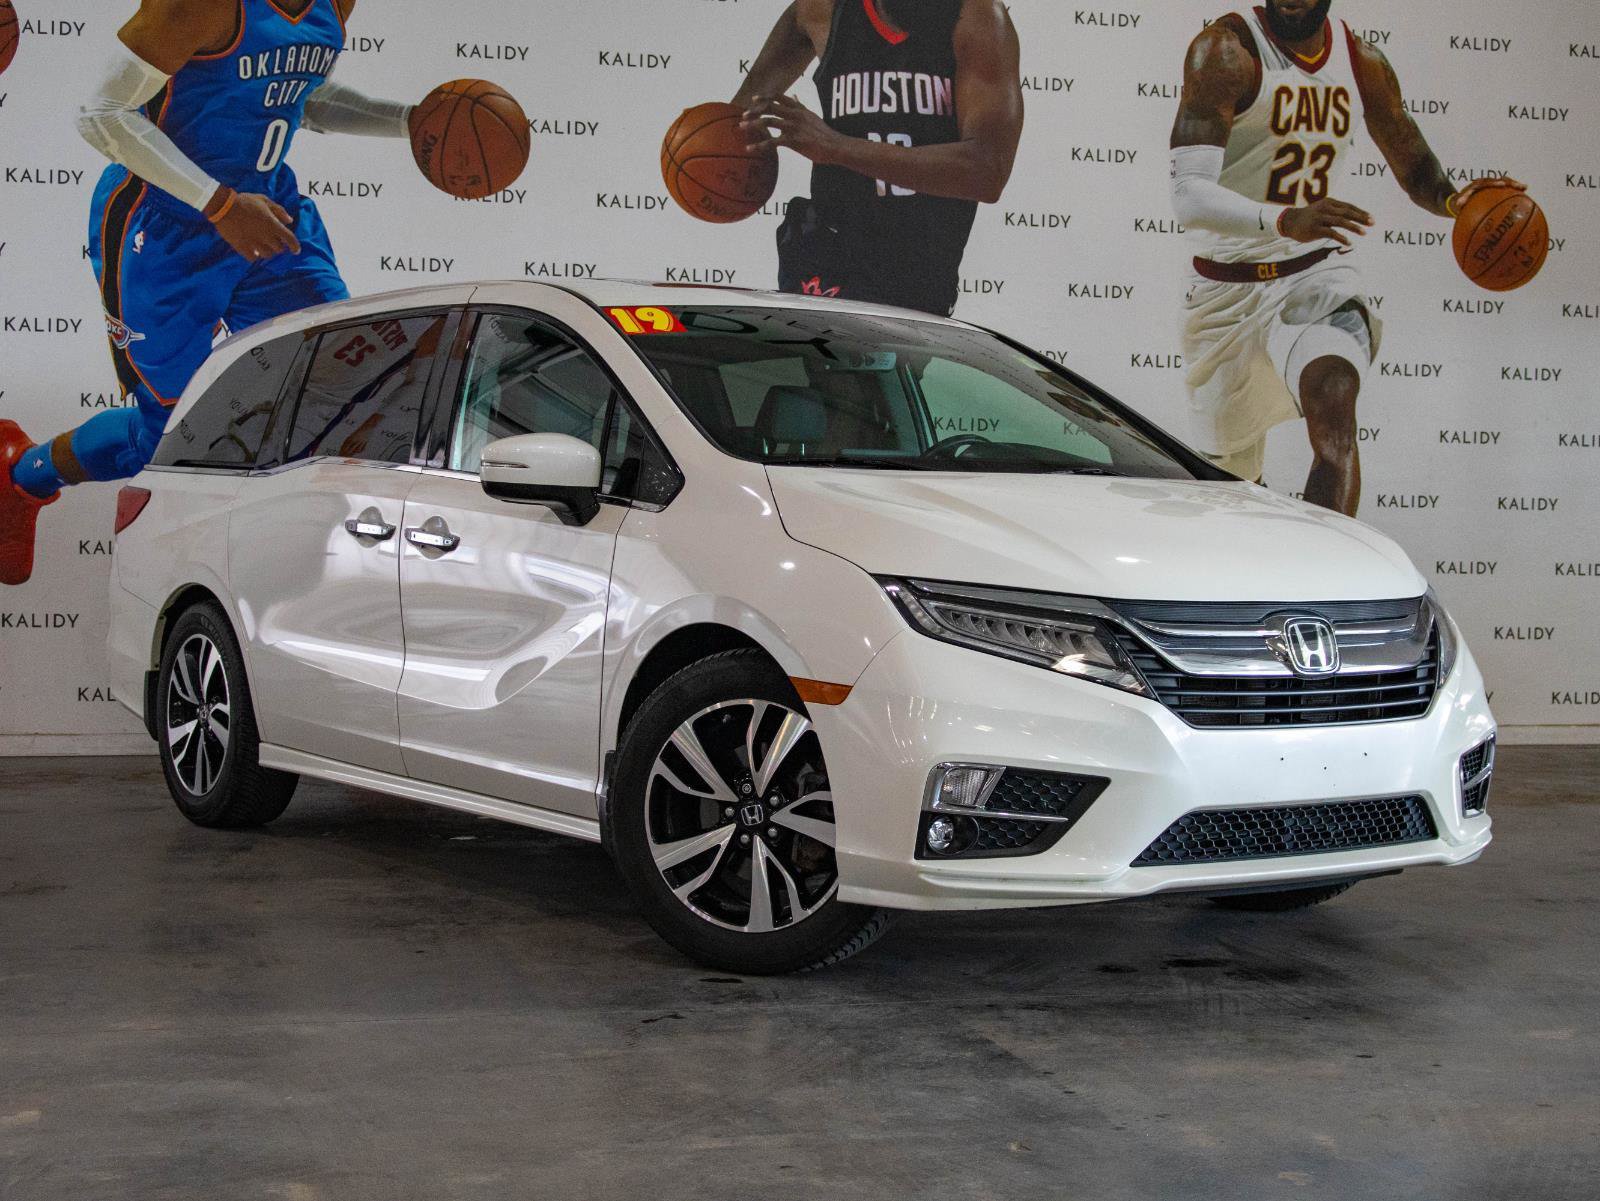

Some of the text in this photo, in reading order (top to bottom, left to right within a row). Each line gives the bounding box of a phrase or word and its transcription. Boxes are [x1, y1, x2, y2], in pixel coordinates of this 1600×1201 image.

[1074, 10, 1142, 29] KALIDY
[341, 36, 385, 53] IDY
[456, 42, 530, 62] KALIDY
[1449, 35, 1513, 53] KALIDY
[598, 50, 672, 70] KALIDY
[263, 79, 310, 108] CITY
[831, 71, 953, 119] HOUSTON
[1270, 85, 1351, 138] CAVS
[1508, 104, 1569, 122] KALIDY
[527, 117, 600, 137] KALIDY
[256, 118, 289, 173] 0
[1071, 146, 1138, 165] KALIDY
[5, 167, 85, 186] KALIDY
[1266, 141, 1336, 206] 23
[1351, 161, 1388, 178] IDY
[307, 181, 383, 199] KALIDY
[596, 193, 669, 212] KALIDY
[1004, 211, 1072, 229] KALIDY
[1384, 229, 1447, 247] KALIDY
[380, 255, 455, 273] KALIDY
[524, 261, 597, 279] KALIDY
[1258, 264, 1279, 281] CLE
[665, 267, 737, 285] KALIDY
[1068, 282, 1135, 300] KALIDY
[1442, 298, 1505, 315] KALIDY
[4, 316, 83, 334] KALIDY
[609, 306, 674, 333] 19
[1380, 361, 1443, 378] KALIDY
[1500, 366, 1562, 382] KALIDY
[934, 416, 1000, 432] KALIDY
[1439, 429, 1501, 445] KALIDY
[1559, 433, 1600, 448] KALI
[1376, 493, 1440, 509] KALIDY
[1497, 496, 1559, 512] KALIDY
[1435, 560, 1498, 575] KALIDY
[0, 612, 80, 629] KALIDY
[1493, 626, 1555, 641] KALIDY
